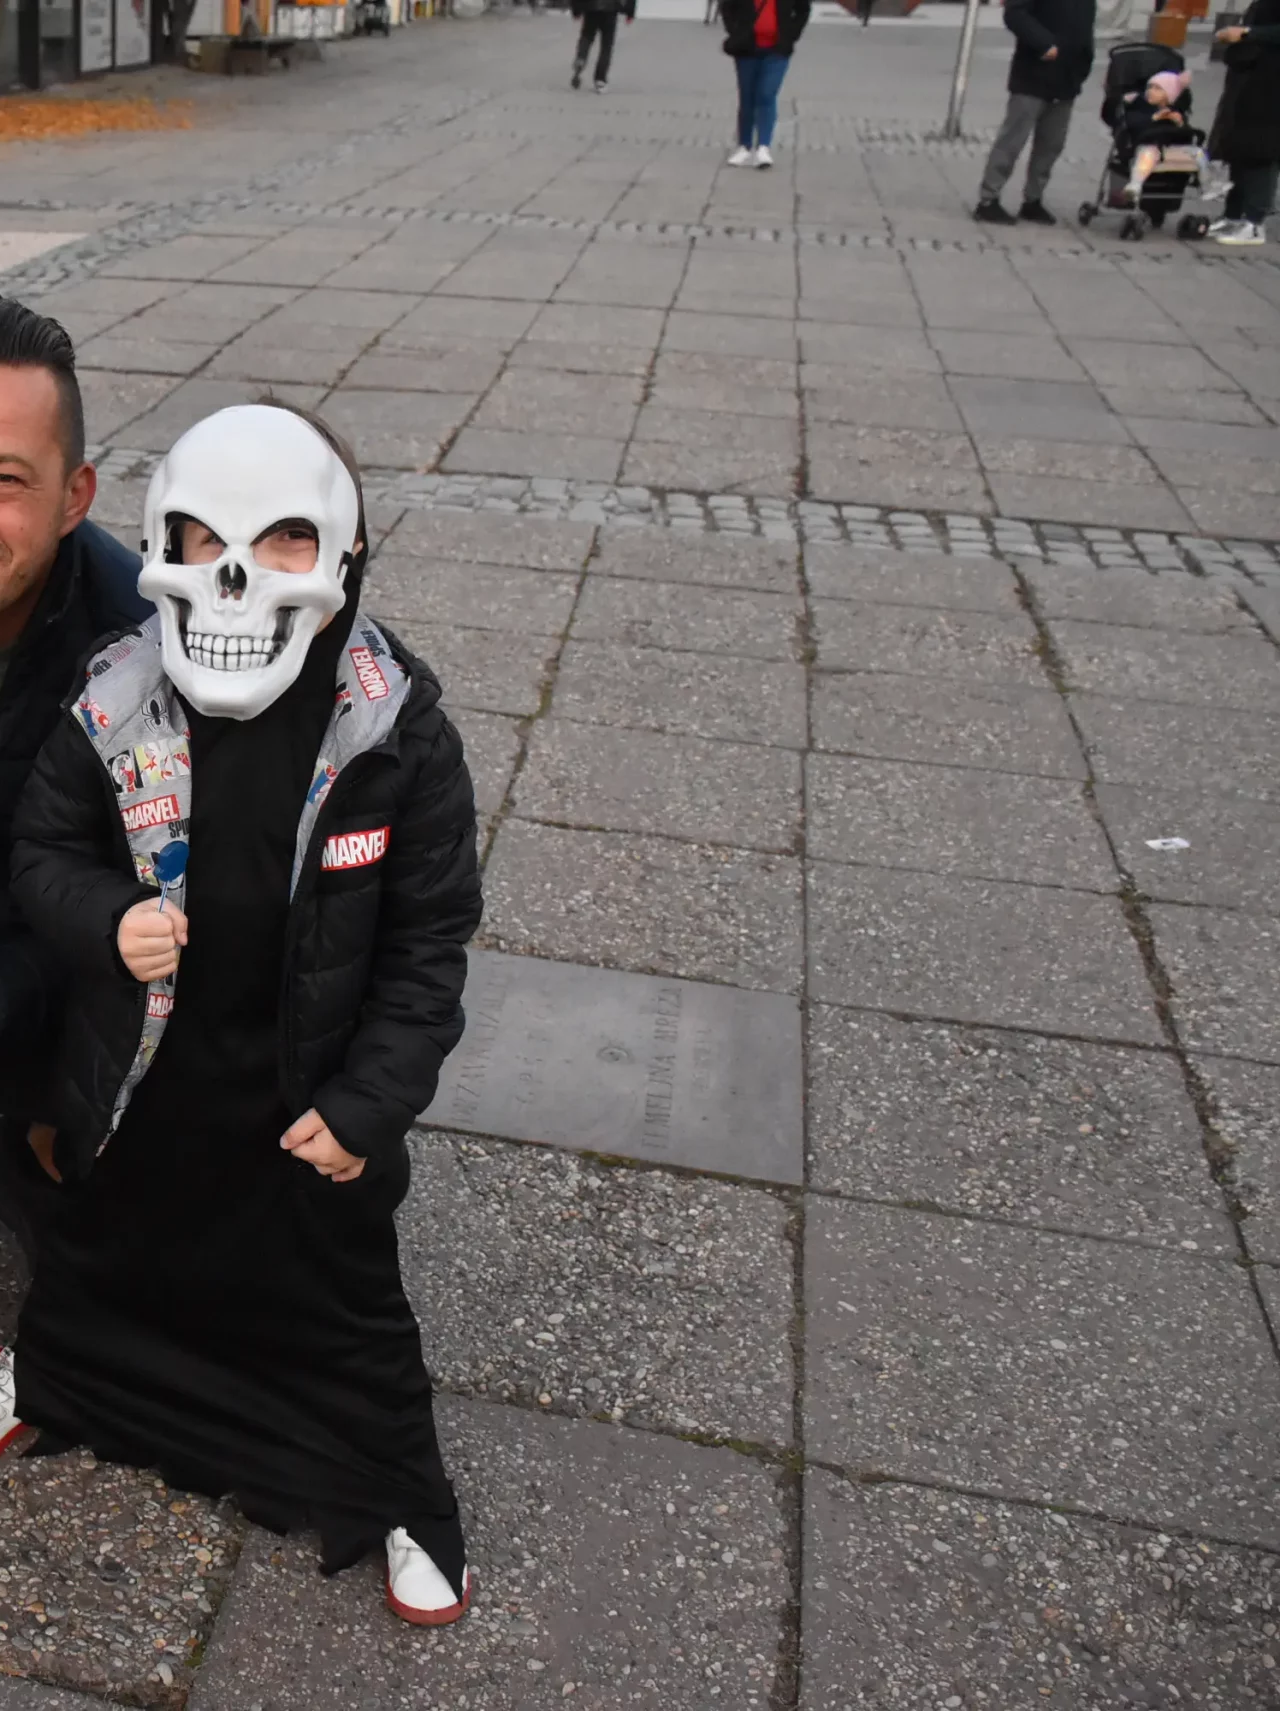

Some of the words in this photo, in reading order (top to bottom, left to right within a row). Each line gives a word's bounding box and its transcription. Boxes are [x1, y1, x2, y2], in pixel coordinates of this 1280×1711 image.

[350, 648, 388, 700] MARVEL
[122, 796, 179, 831] MARVEL
[321, 829, 387, 868] MARVEL
